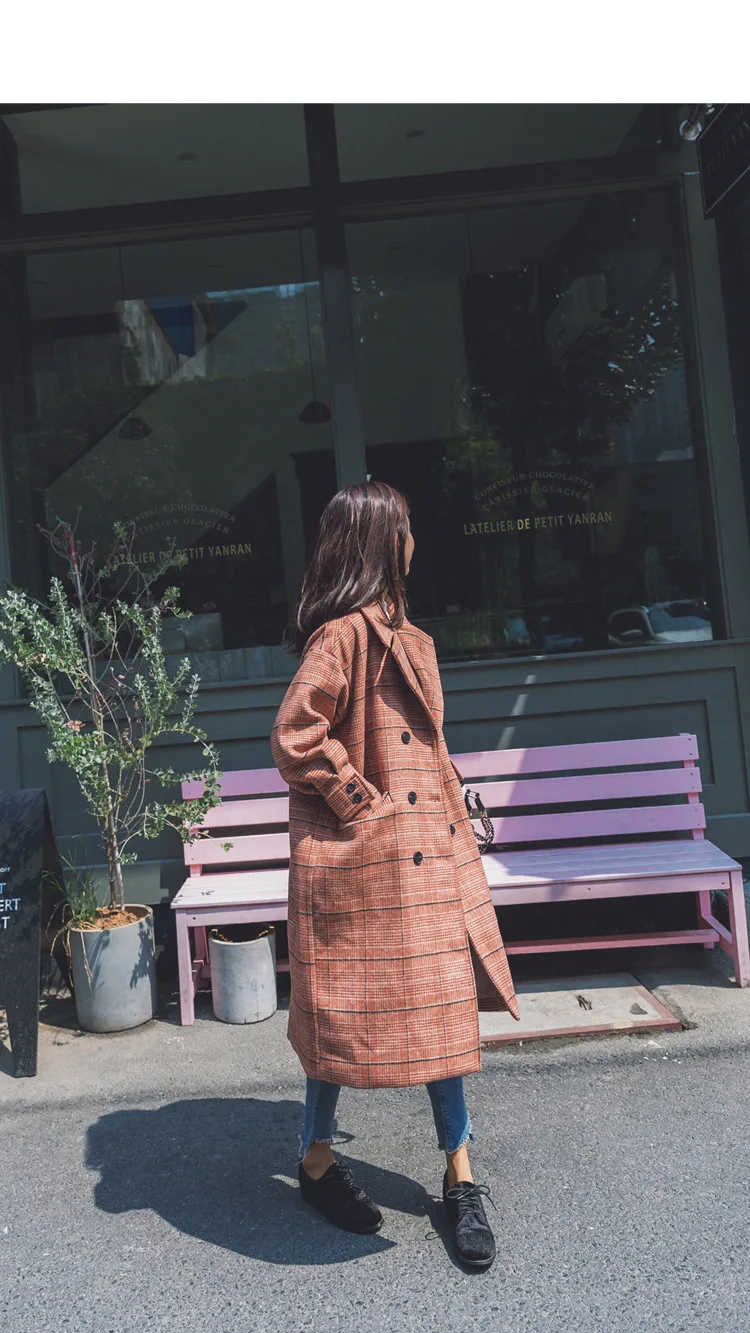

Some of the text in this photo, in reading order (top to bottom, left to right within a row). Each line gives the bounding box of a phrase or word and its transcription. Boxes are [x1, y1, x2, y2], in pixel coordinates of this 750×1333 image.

[516, 517, 531, 531] DE
[534, 515, 564, 529] PETIT
[567, 511, 613, 527] YANRAN
[208, 543, 252, 558] YANRAN
